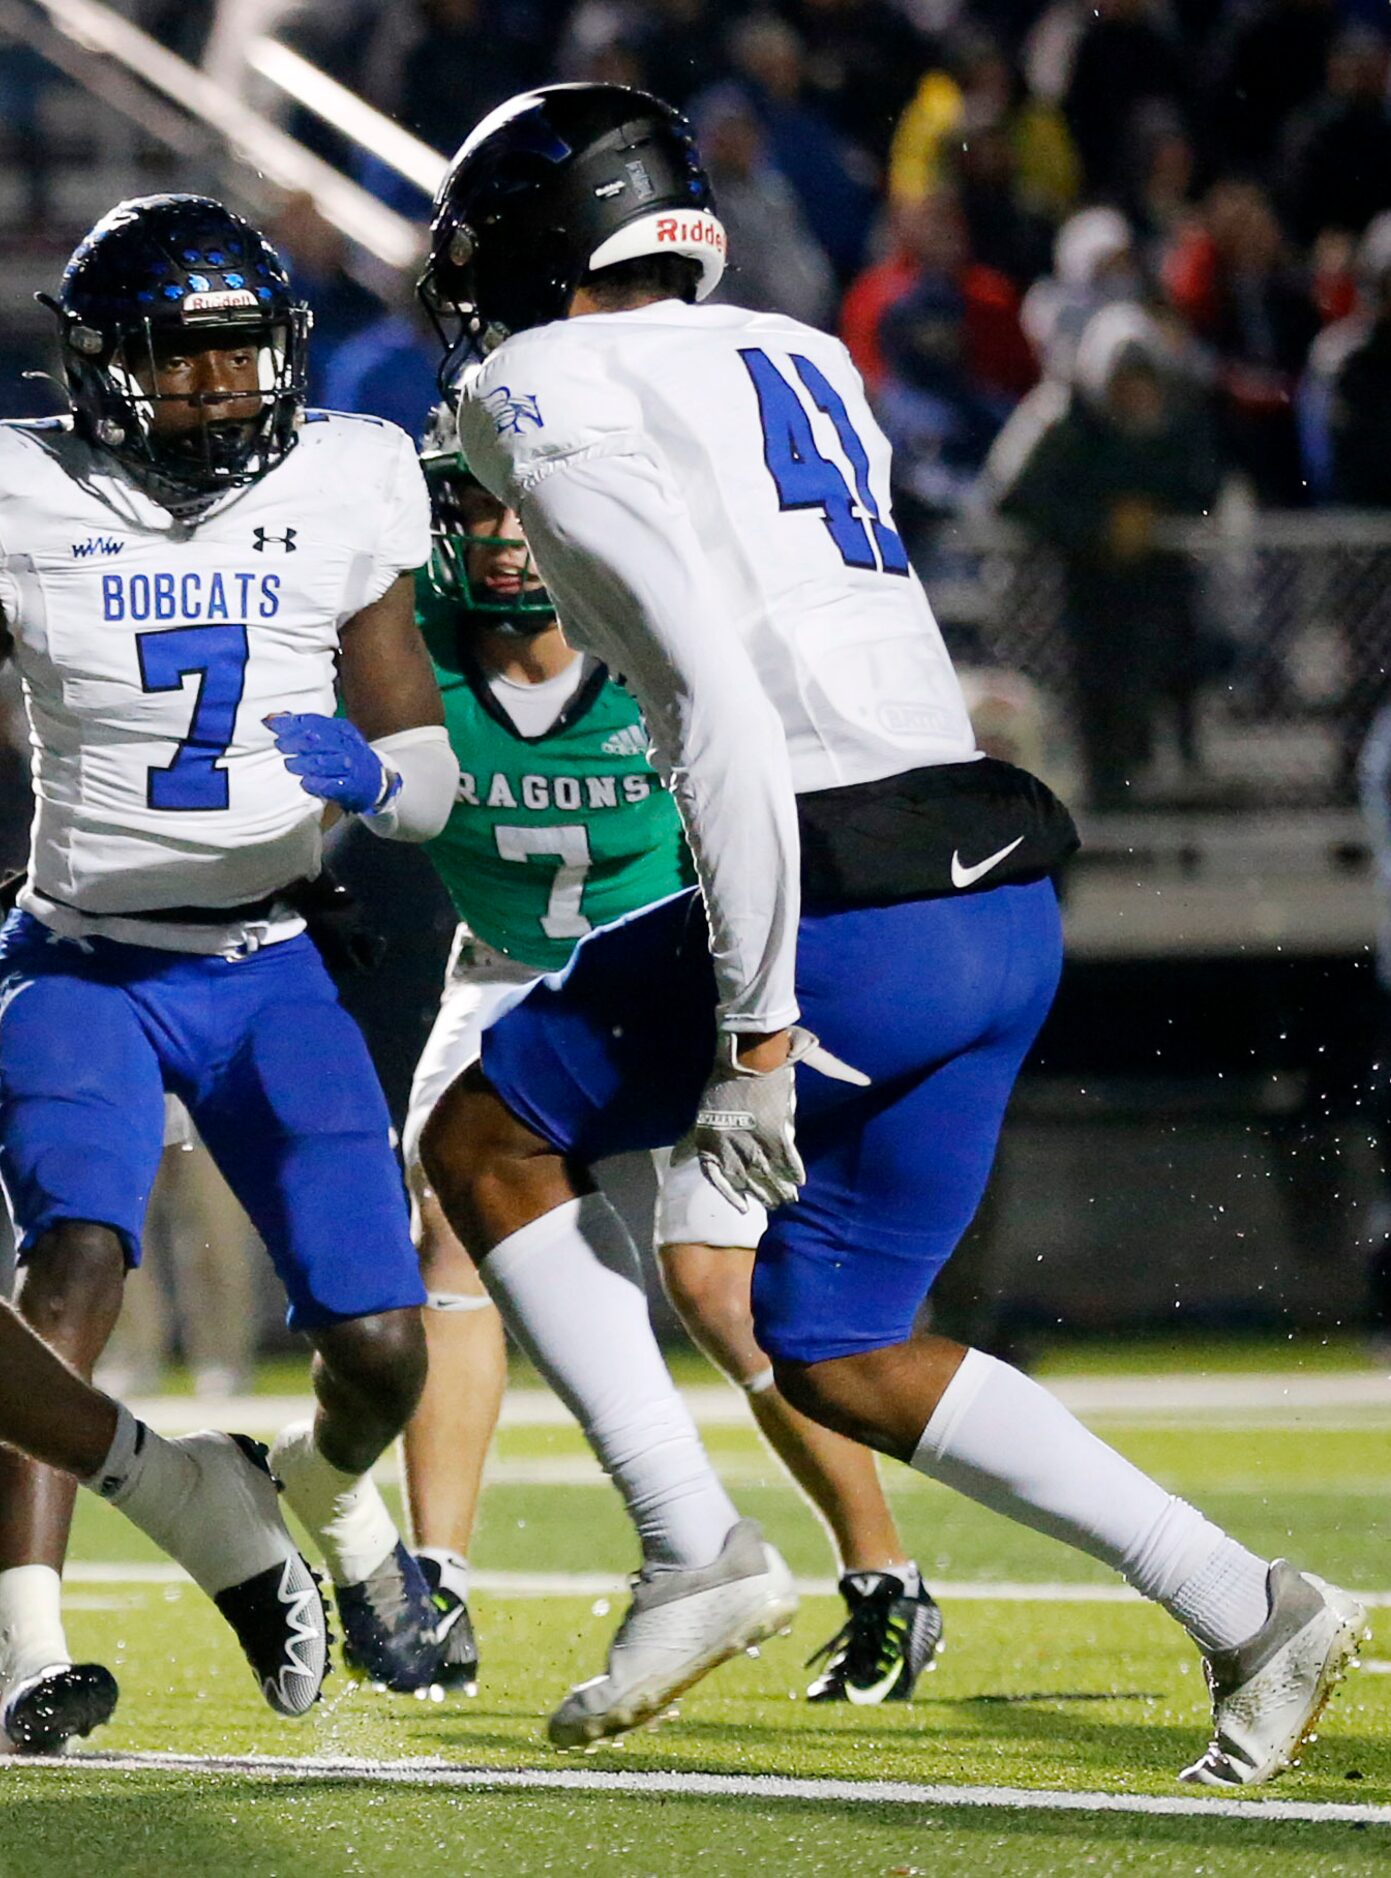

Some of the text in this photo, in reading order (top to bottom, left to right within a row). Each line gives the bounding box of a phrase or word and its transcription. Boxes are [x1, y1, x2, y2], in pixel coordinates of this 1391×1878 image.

[657, 219, 726, 250] Ridde
[735, 347, 910, 578] 41
[102, 572, 281, 622] BOBCATS
[135, 623, 250, 811] 7
[458, 771, 651, 810] RAGONS
[493, 824, 593, 938] 7
